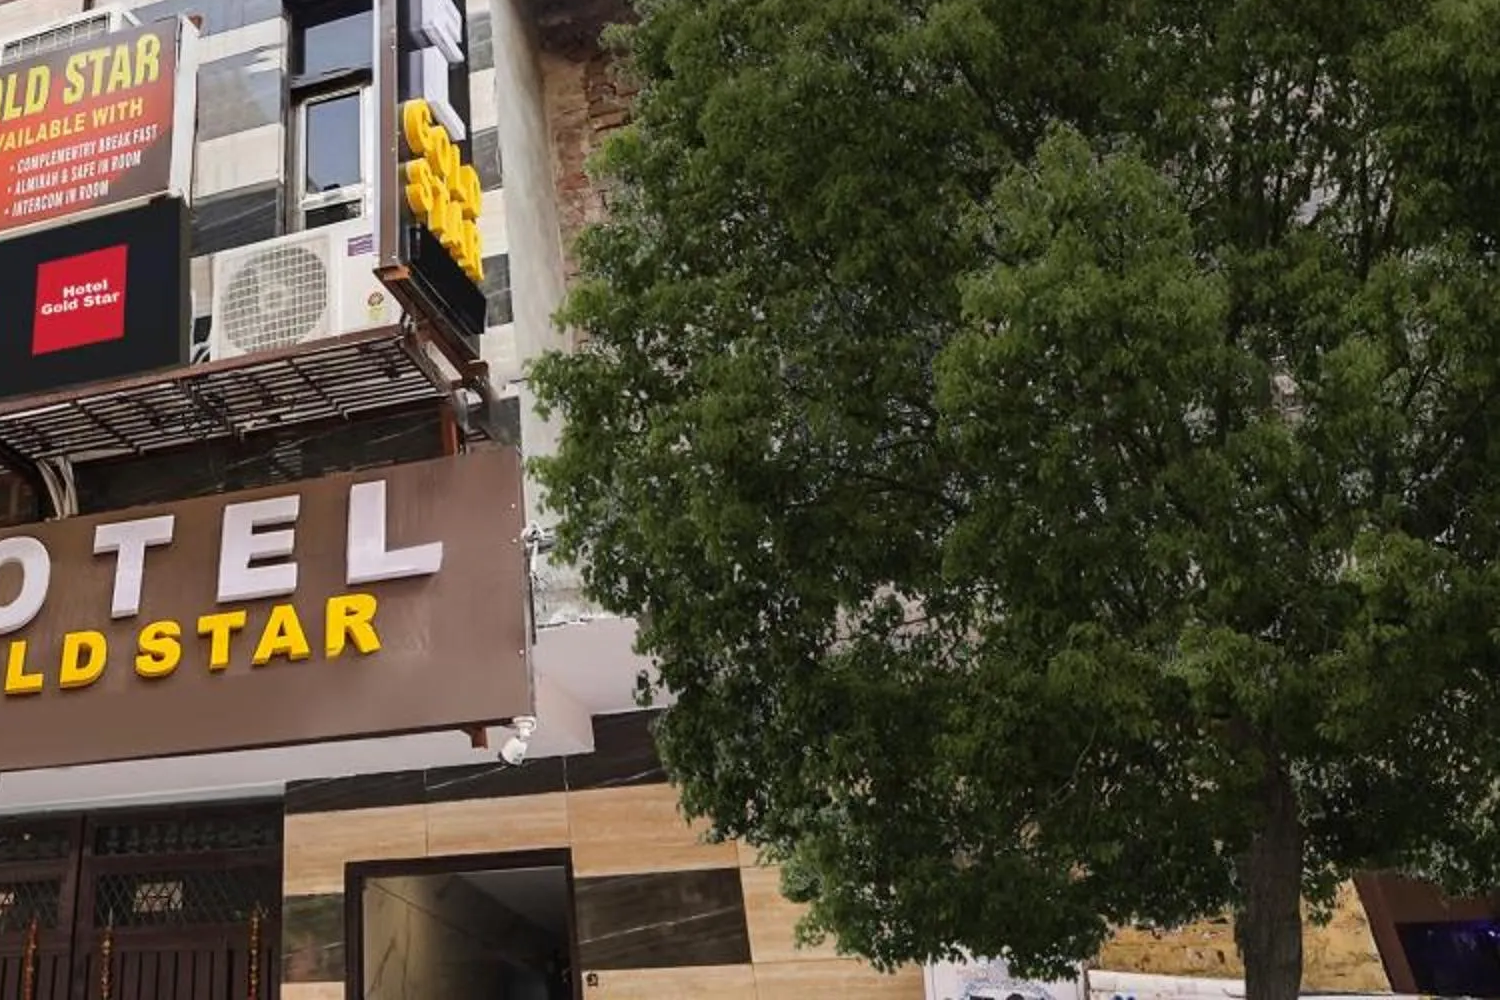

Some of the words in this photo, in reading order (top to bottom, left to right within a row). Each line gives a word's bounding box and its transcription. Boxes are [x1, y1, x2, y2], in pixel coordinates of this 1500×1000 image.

[63, 33, 162, 105] STAR
[92, 97, 144, 130] WITH
[15, 171, 60, 195] ALMIRAH
[71, 163, 95, 182] SAFE
[97, 159, 109, 174] IN
[111, 151, 142, 171] ROOM
[11, 190, 63, 217] INTERCOM
[65, 188, 77, 205] IN
[79, 180, 109, 201] ROOM
[41, 298, 80, 316] Gold
[83, 290, 120, 308] Star
[62, 279, 108, 299] Hotel
[134, 593, 383, 678] STAR
